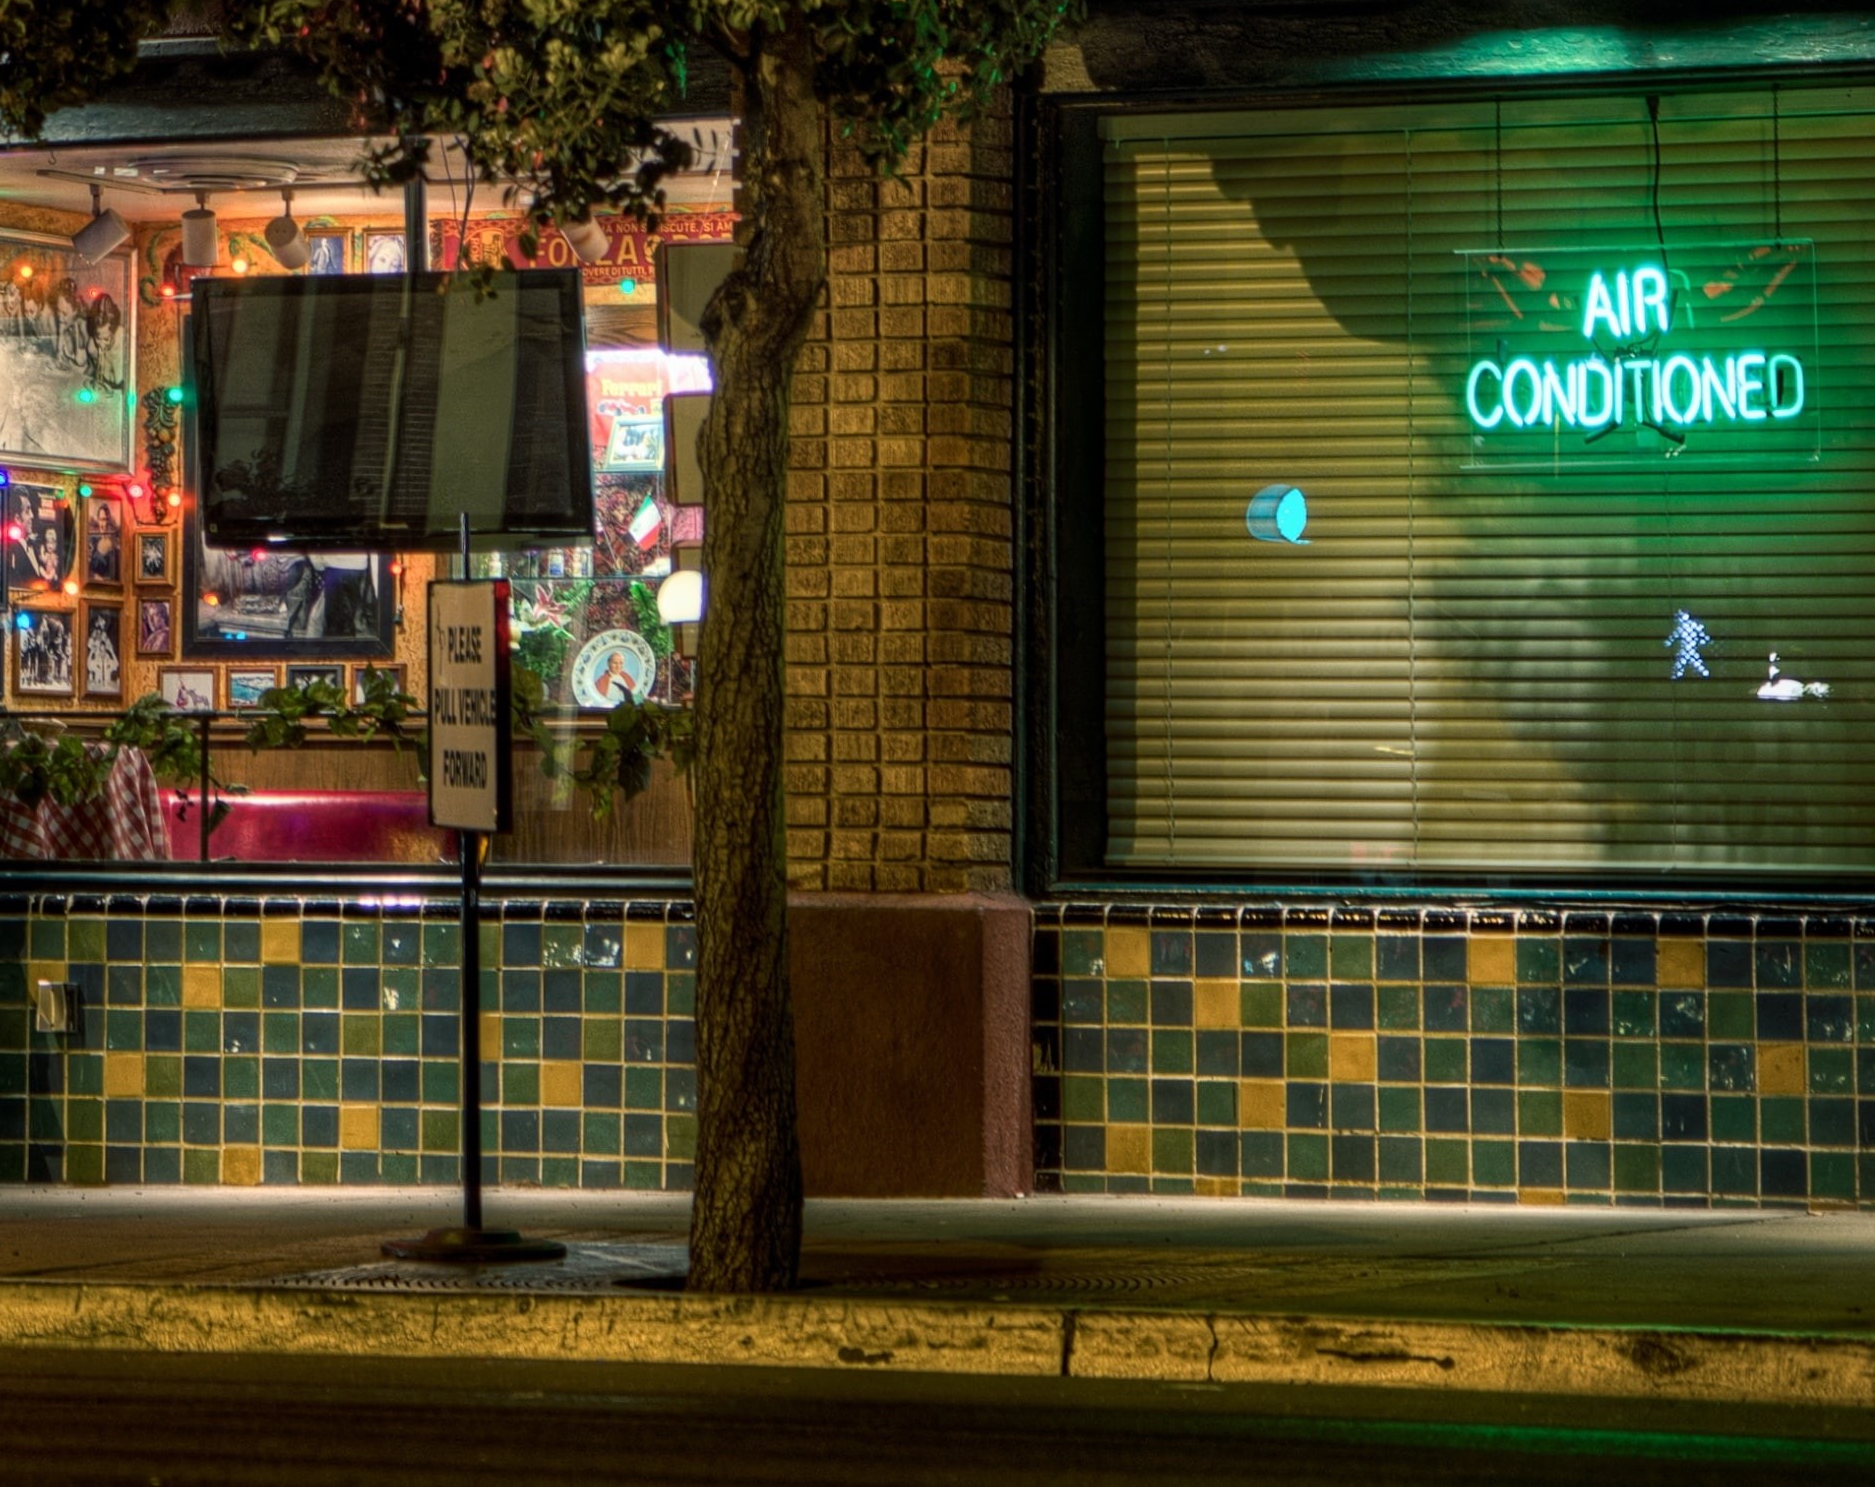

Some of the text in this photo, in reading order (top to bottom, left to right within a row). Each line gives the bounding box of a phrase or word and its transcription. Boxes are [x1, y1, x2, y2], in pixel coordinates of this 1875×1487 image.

[1582, 266, 1670, 339] AIR
[1465, 353, 1805, 428] CONDITIONED
[447, 625, 482, 663] PLEASE
[434, 688, 496, 727] PULL VEHICLE
[443, 749, 487, 789] FORWARD
